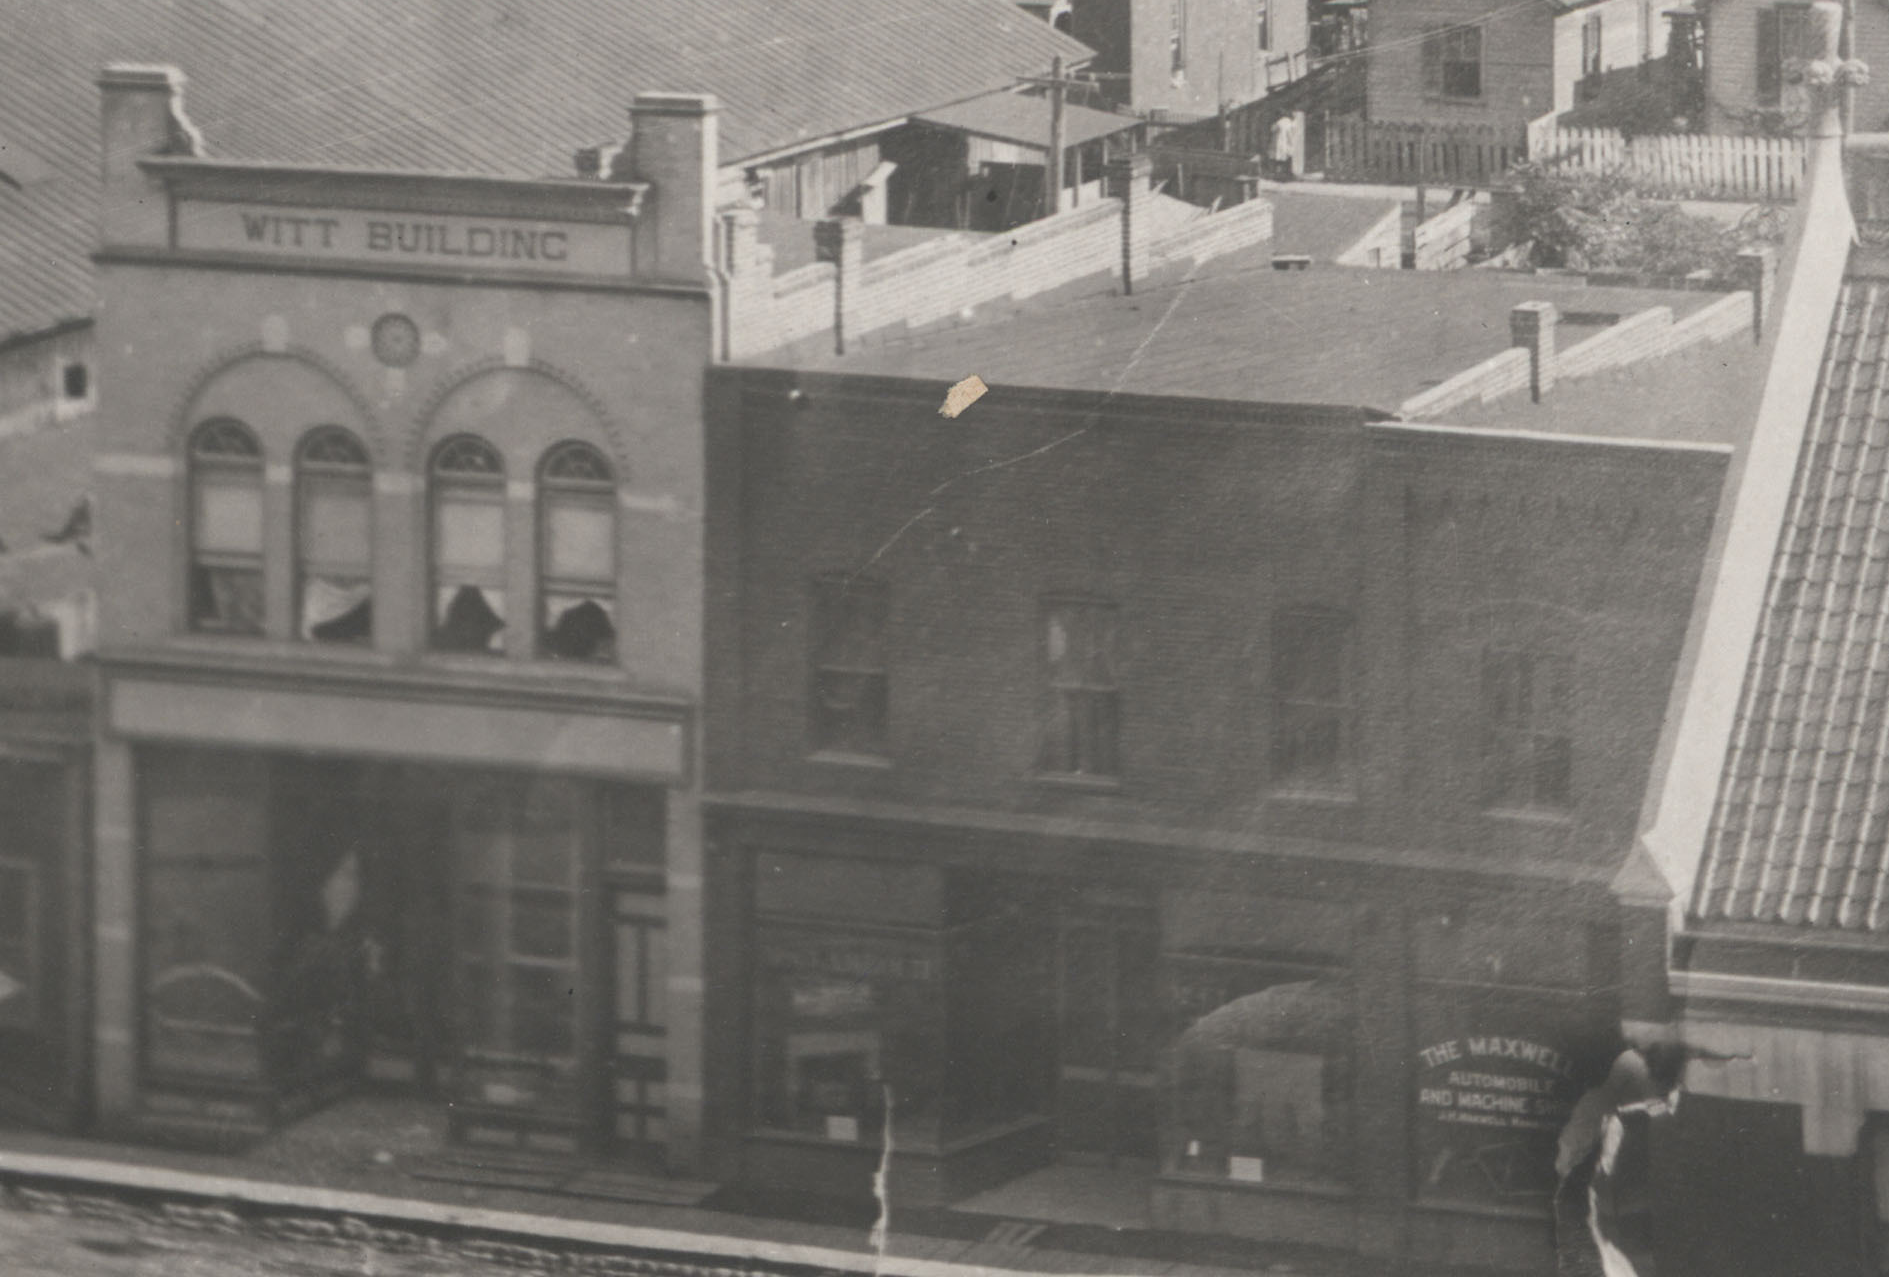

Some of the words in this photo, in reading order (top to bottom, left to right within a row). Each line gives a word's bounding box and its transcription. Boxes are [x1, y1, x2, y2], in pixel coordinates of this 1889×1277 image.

[241, 213, 340, 246] WITT
[366, 220, 567, 260] BUILDING
[1419, 1039, 1461, 1067] THE
[1419, 1088, 1453, 1106] AND
[1457, 1092, 1530, 1114] MACHINE
